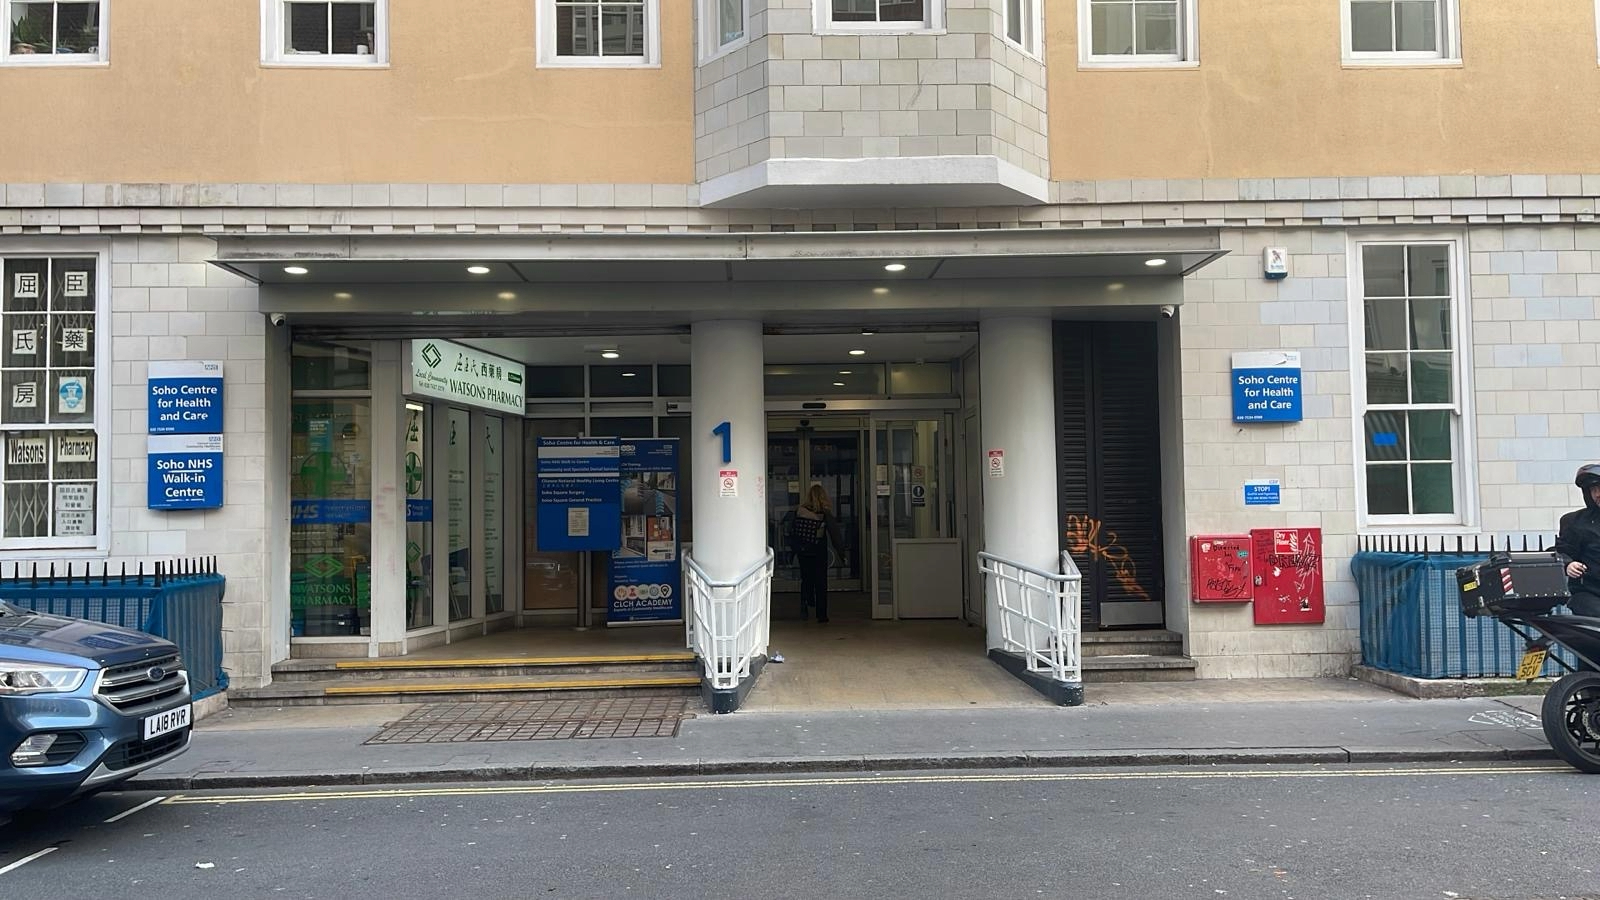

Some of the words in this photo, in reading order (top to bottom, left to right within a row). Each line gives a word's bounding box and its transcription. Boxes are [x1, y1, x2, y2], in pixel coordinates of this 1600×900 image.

[17, 275, 36, 294] 屈
[66, 274, 84, 292] 臣
[15, 331, 34, 351] 氏
[64, 330, 84, 349] 藥
[1238, 375, 1264, 385] Soho
[1267, 375, 1298, 384] Centre
[15, 384, 35, 404] 房
[152, 385, 178, 395] Soho
[180, 385, 218, 395] Centre
[449, 379, 486, 400] WATSONS
[487, 388, 523, 408] PHARMACY
[1244, 388, 1260, 397] for
[1262, 388, 1294, 397] Health
[157, 398, 173, 408] for
[175, 397, 211, 408] Health
[1247, 400, 1268, 410] and
[1270, 400, 1292, 409] Care
[160, 411, 180, 421] and
[182, 411, 208, 421] Care
[712, 421, 732, 464] 1
[11, 439, 44, 463] Watsons
[60, 436, 93, 460] Pharmacy
[157, 458, 185, 470] Soho
[188, 458, 213, 469] NHS
[163, 473, 206, 484] Walk-in
[165, 487, 204, 497] Centre
[1275, 532, 1286, 540] Dry
[613, 600, 634, 608] CLCH
[635, 598, 673, 607] ACADEMY
[1522, 653, 1545, 667] LJ75
[150, 715, 168, 735] LA18
[171, 709, 186, 728] RVR
